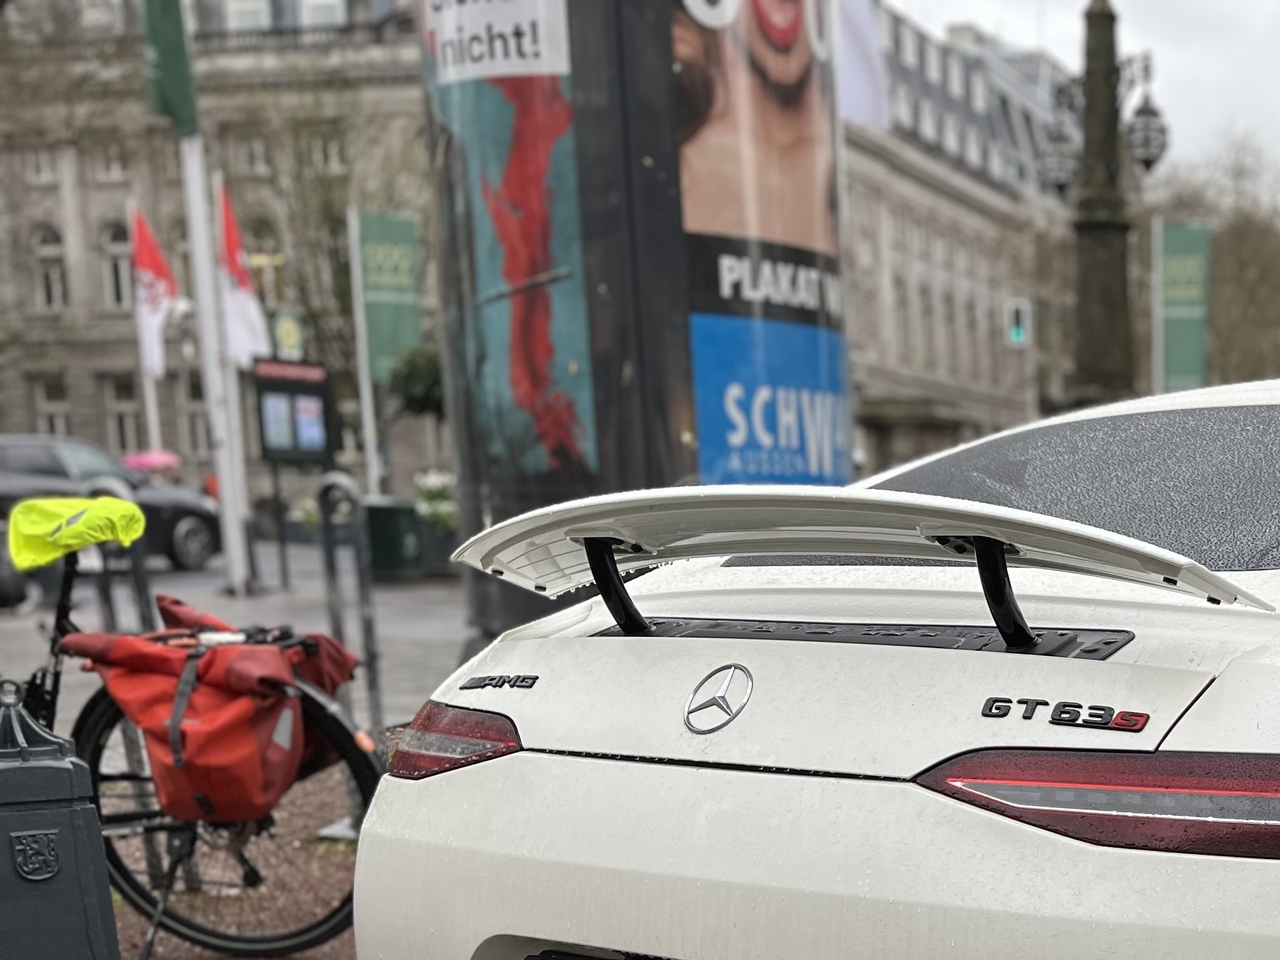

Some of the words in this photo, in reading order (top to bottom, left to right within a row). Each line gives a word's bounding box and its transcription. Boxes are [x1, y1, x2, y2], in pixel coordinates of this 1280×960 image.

[440, 19, 540, 68] nicht!
[718, 254, 821, 310] PLAKAT
[480, 674, 539, 689] AMG
